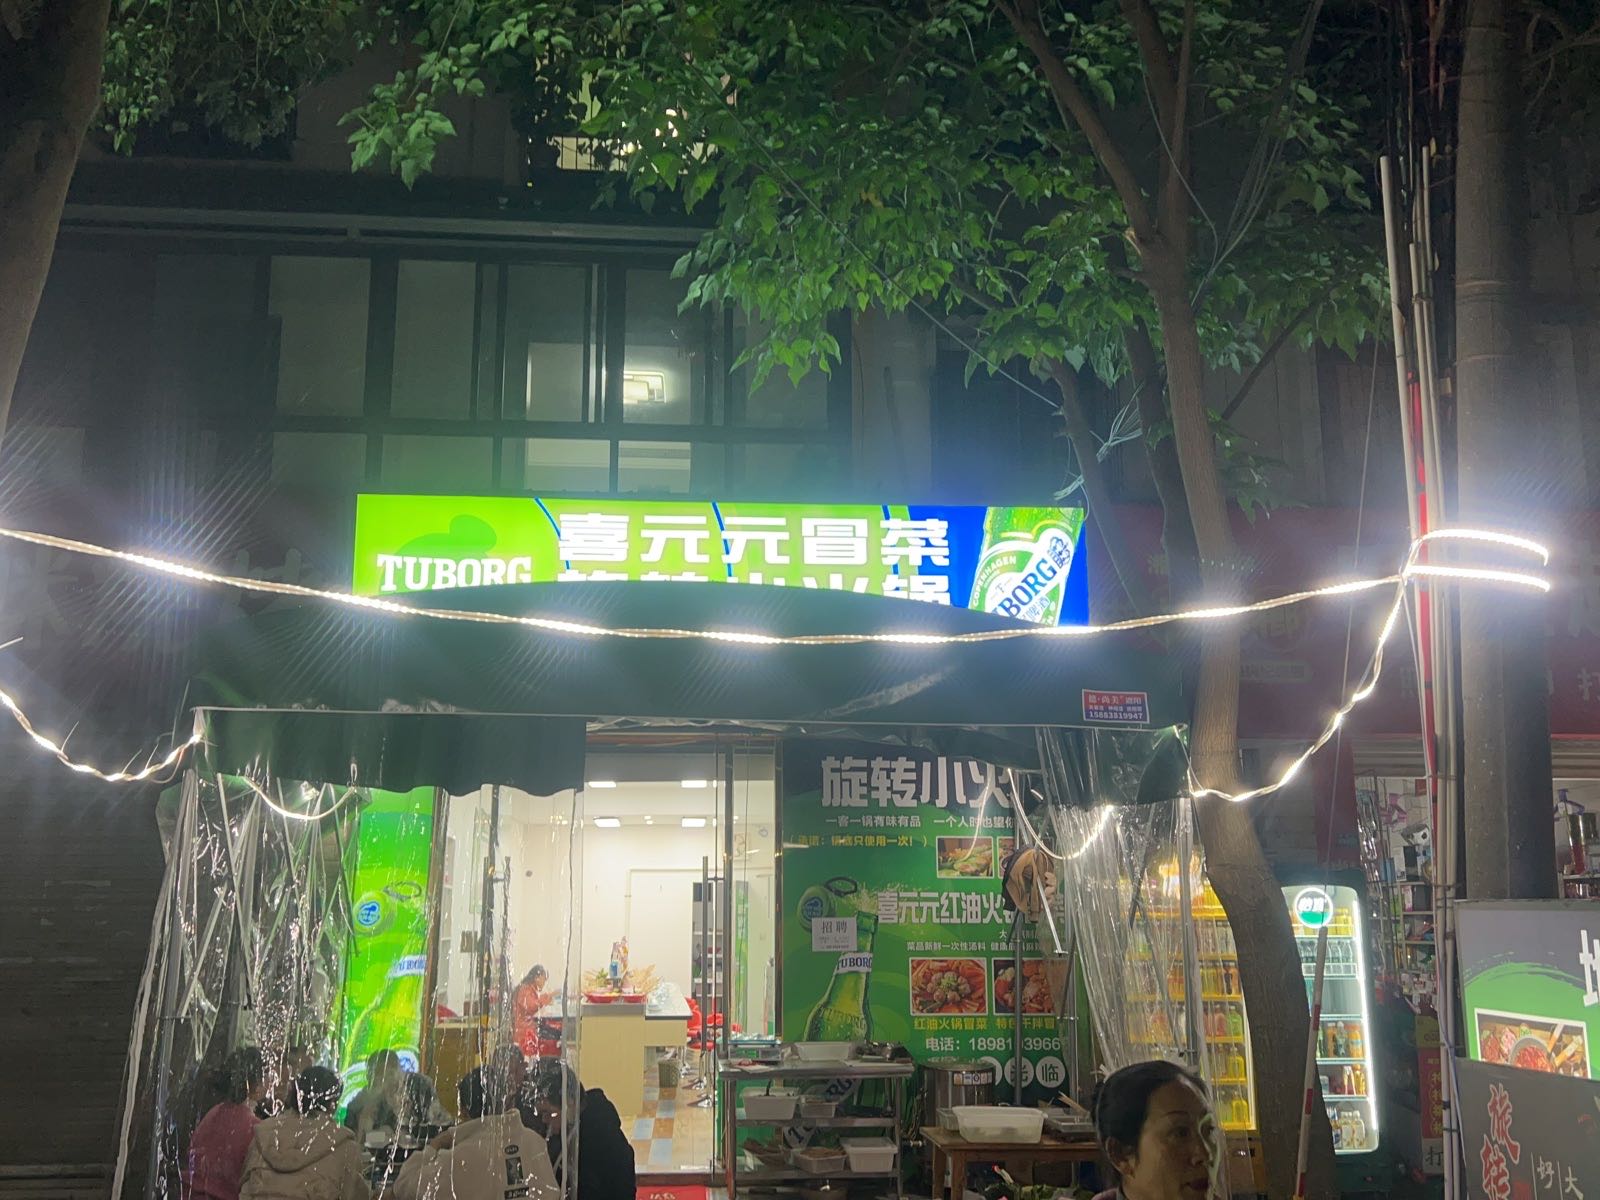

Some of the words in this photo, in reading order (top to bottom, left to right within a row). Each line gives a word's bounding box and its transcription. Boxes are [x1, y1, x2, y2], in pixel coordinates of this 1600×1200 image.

[559, 513, 950, 566] 喜元元冒菜
[376, 553, 532, 592] TUBORG
[993, 557, 1058, 618] BORG
[877, 892, 1014, 924] 喜元元红油火
[914, 1018, 987, 1030] 红油火锅冒菜
